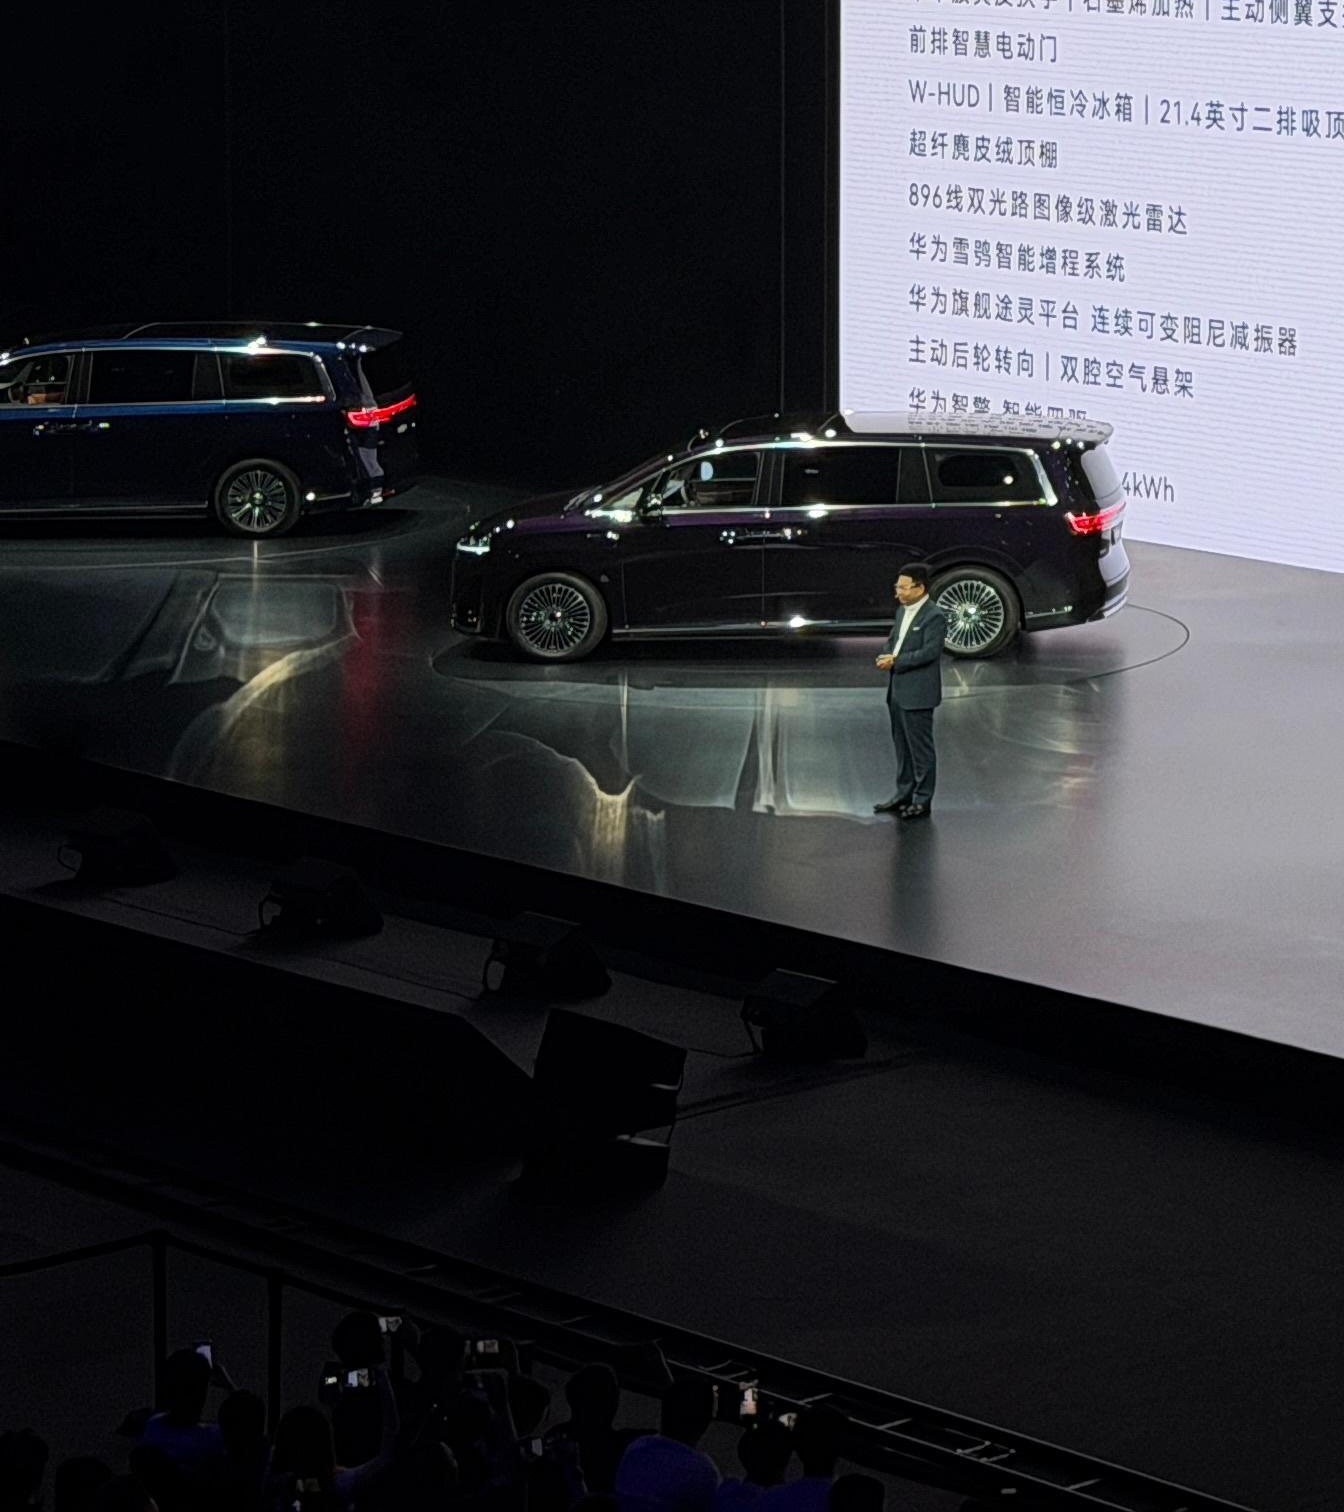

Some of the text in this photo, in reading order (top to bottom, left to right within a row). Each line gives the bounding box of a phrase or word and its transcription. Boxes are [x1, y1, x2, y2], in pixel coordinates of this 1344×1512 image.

[908, 24, 1057, 63] 前排智慧电动门
[908, 79, 980, 108] W-HUD
[1003, 84, 1134, 123] 智能恒冷冰箱
[908, 128, 1058, 169] 超纤麂皮绒顶棚
[908, 182, 1188, 236] 896线双光路图像级激光雷达
[908, 283, 1297, 357] 华为旗舰途灵平台 连续可变阻尼减振器
[908, 335, 1194, 399] 主动后轮转向 双腔空气悬架
